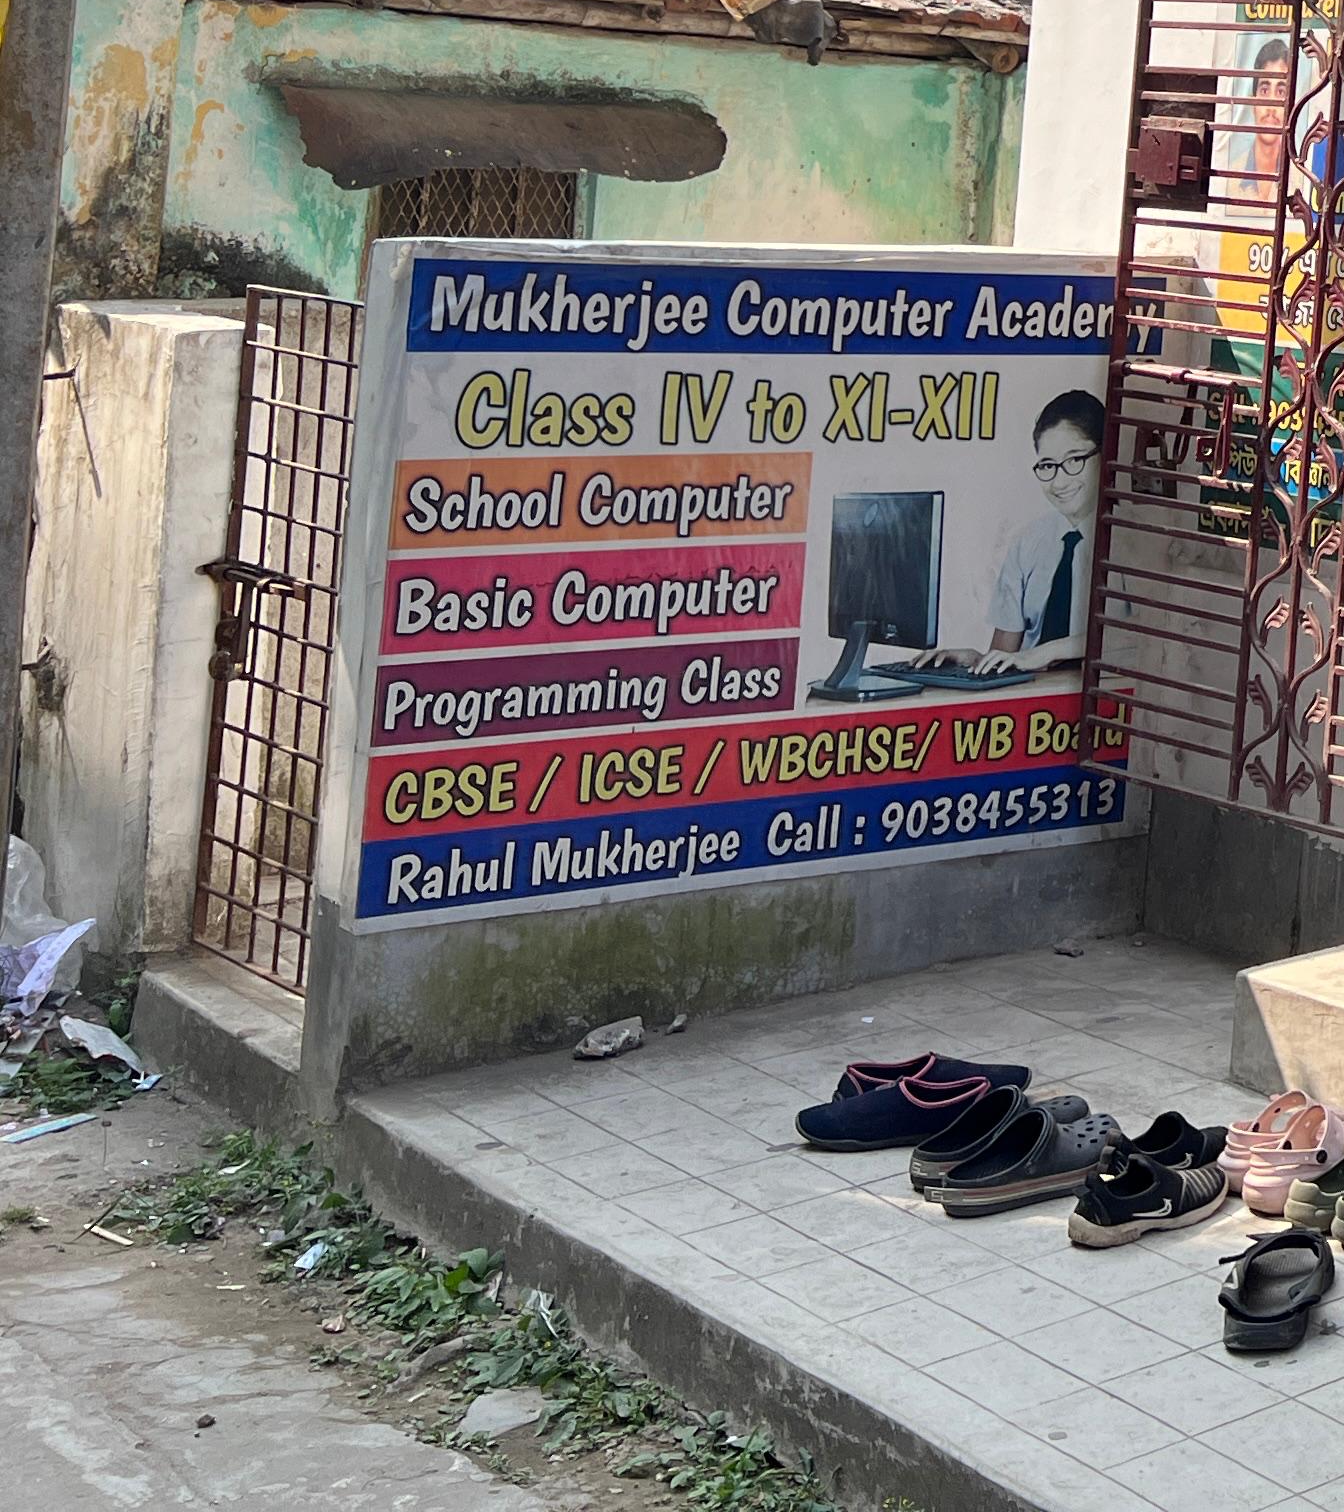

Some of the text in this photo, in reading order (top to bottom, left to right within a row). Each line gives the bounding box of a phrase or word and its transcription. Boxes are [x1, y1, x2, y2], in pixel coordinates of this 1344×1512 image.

[430, 273, 710, 350] Mukherjee
[725, 280, 955, 351] Computer
[455, 368, 1000, 449] Class IV to XI-XII
[404, 474, 794, 540] School Computer
[394, 570, 778, 636] Basic Computer
[382, 659, 783, 736] Programming Class
[383, 768, 521, 825] CBSE
[578, 746, 685, 804] ICSE
[953, 714, 1016, 763] WB
[387, 841, 516, 905] Rahul
[531, 829, 740, 893] Mukherjee
[767, 805, 841, 855] Call
[881, 778, 1117, 843] 9038455313
